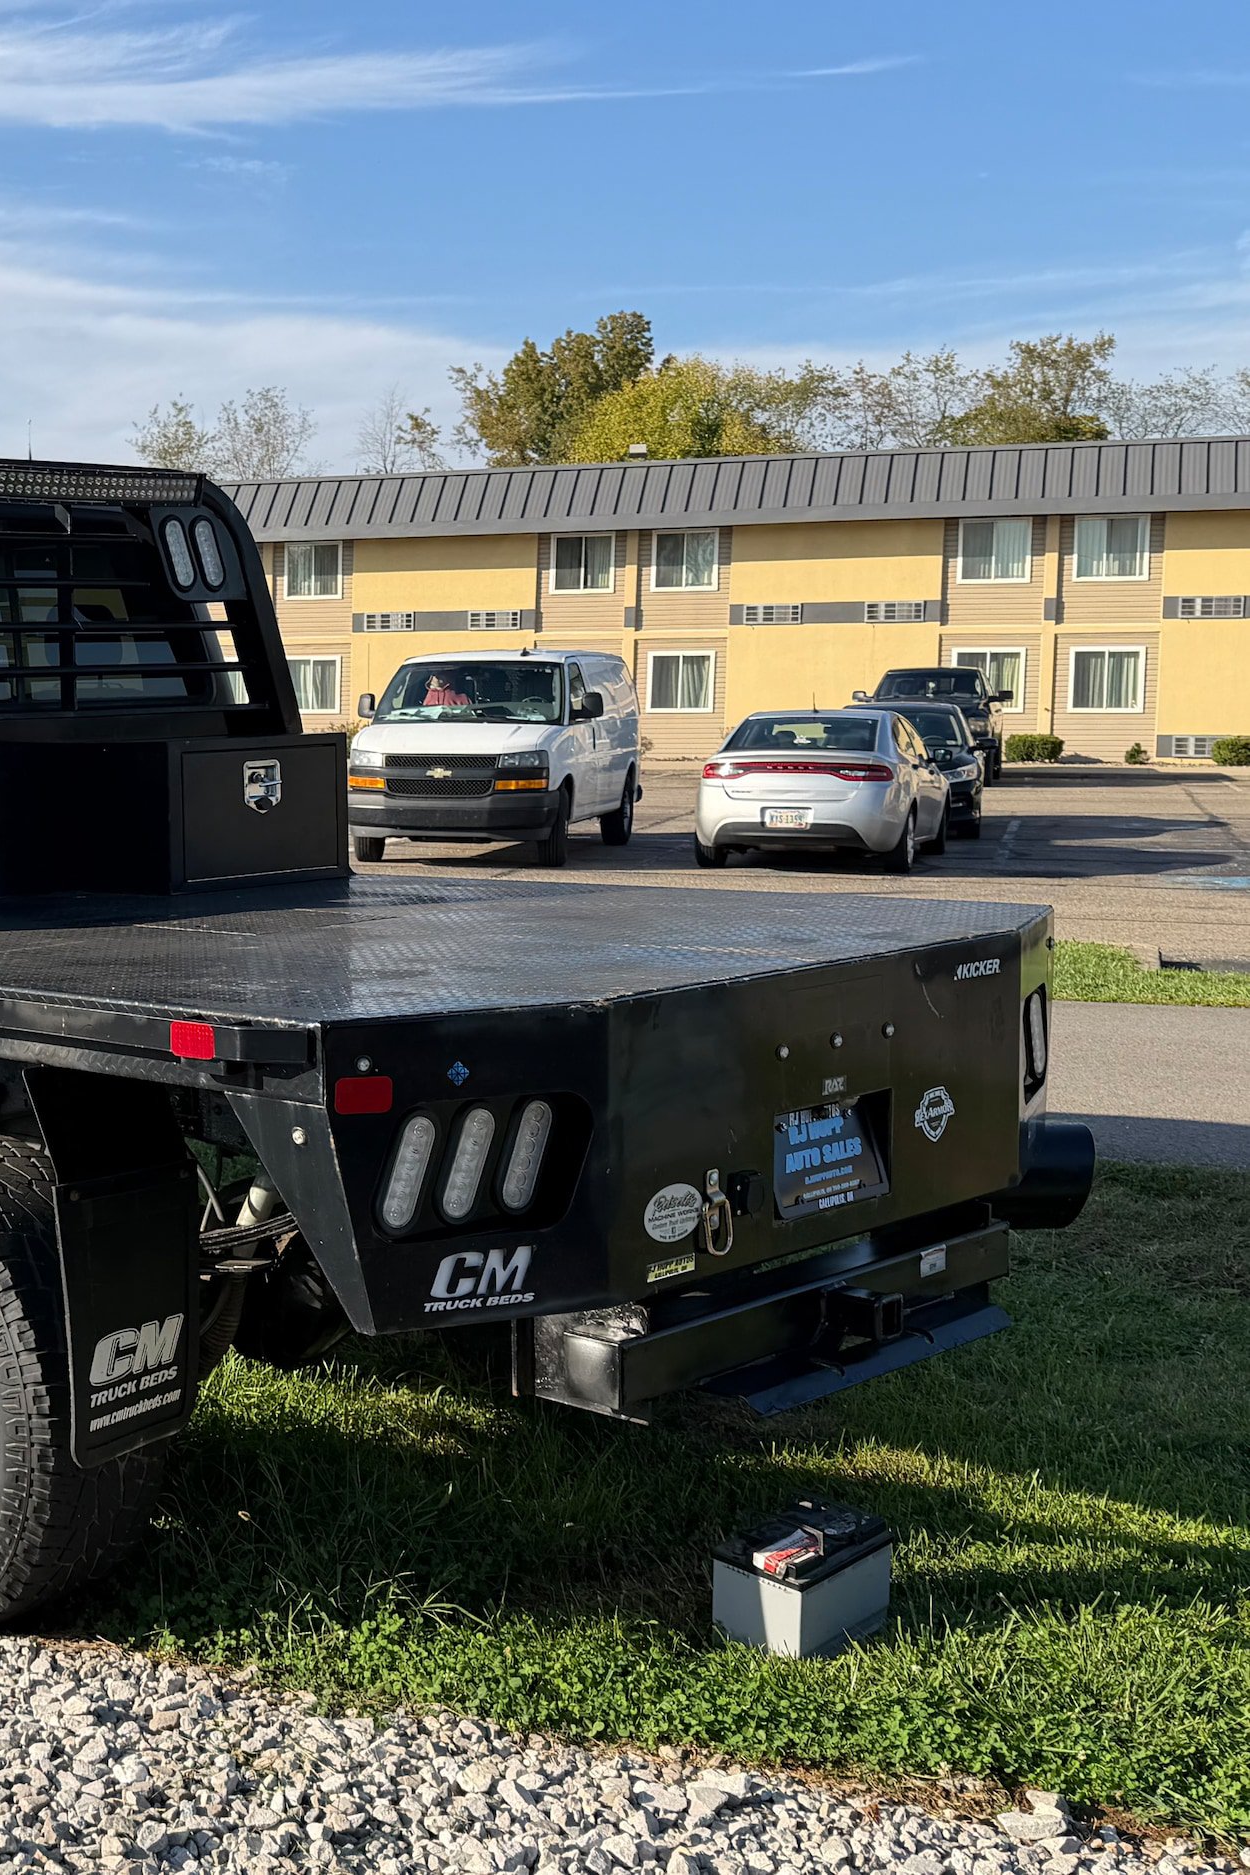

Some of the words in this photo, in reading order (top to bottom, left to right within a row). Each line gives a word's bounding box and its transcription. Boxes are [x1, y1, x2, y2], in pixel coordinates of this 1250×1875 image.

[962, 959, 1000, 979] KICKER
[785, 1147, 821, 1174] AUTO
[822, 1137, 862, 1163] SALES
[430, 1245, 532, 1299] CM
[424, 1298, 483, 1312] TRUCK
[486, 1293, 535, 1307] BEDS
[89, 1313, 185, 1387] CM
[91, 1380, 137, 1408] TRUCK
[139, 1366, 179, 1390] BEDS
[90, 1389, 182, 1432] www.cmtruckbeds.com
